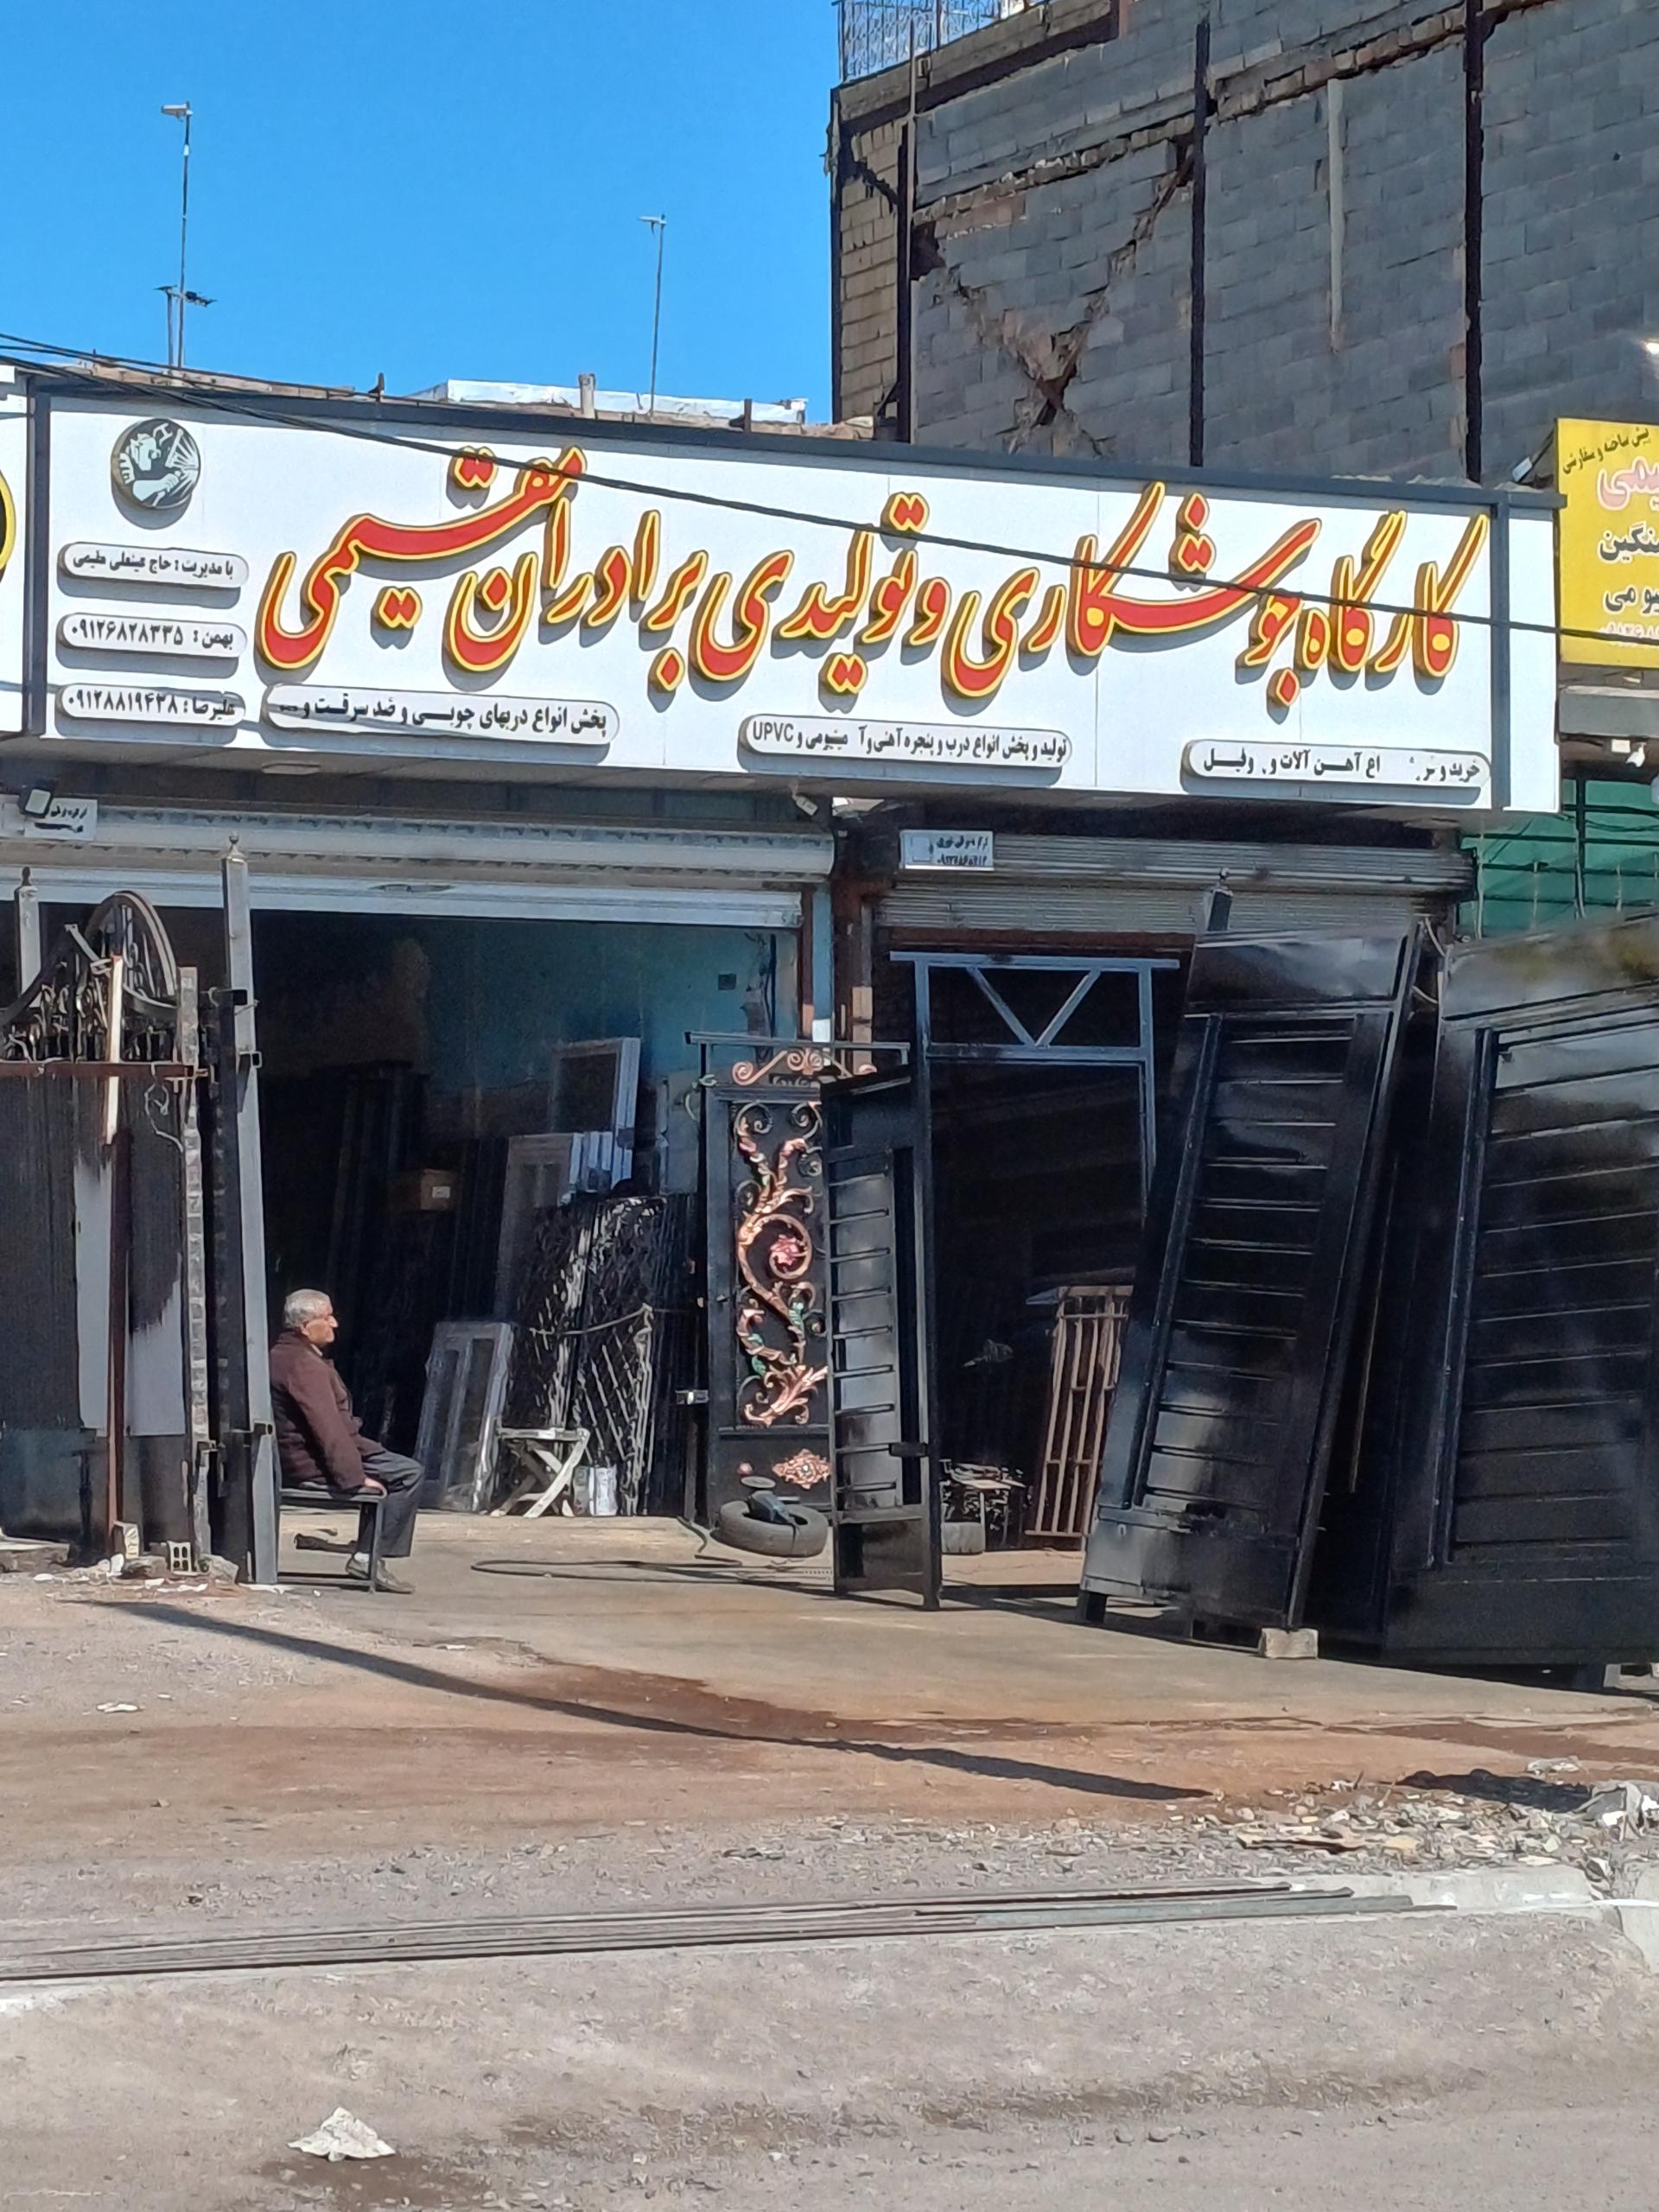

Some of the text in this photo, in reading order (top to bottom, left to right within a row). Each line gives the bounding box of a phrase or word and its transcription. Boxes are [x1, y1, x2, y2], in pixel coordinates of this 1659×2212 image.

[149, 556, 171, 574] حاج
[226, 561, 233, 580] با
[448, 498, 707, 692] برادران
[693, 493, 927, 693] تولیدی
[949, 480, 1320, 707] جوشکاری
[1300, 510, 1490, 677] کارگاه
[71, 619, 183, 645] ۰۹۱۲۶۸۲۸۳۳۵
[68, 690, 178, 715] ۰۹۱۲۸۸۱۹۴۳۸
[302, 702, 310, 719] و
[315, 693, 369, 722] سرقت
[372, 697, 396, 716] ضد
[400, 707, 408, 725] و
[412, 706, 475, 729] چوبی
[480, 702, 528, 732] دربهای
[531, 705, 568, 733] انواع
[571, 708, 607, 737] پخش
[753, 721, 794, 742] UPVC
[796, 732, 803, 749] و
[874, 728, 903, 753] آهنی
[866, 737, 872, 754] و
[904, 734, 934, 756] پنجره
[937, 738, 943, 756] و
[945, 736, 969, 758] درب
[972, 734, 1000, 759] انواع
[1002, 734, 1029, 760] پخش
[1031, 744, 1038, 761] و
[1040, 737, 1066, 763] تولید
[1269, 758, 1277, 775] و
[1280, 749, 1311, 770] آلات
[1313, 752, 1363, 776] آهن
[1439, 765, 1446, 781] و
